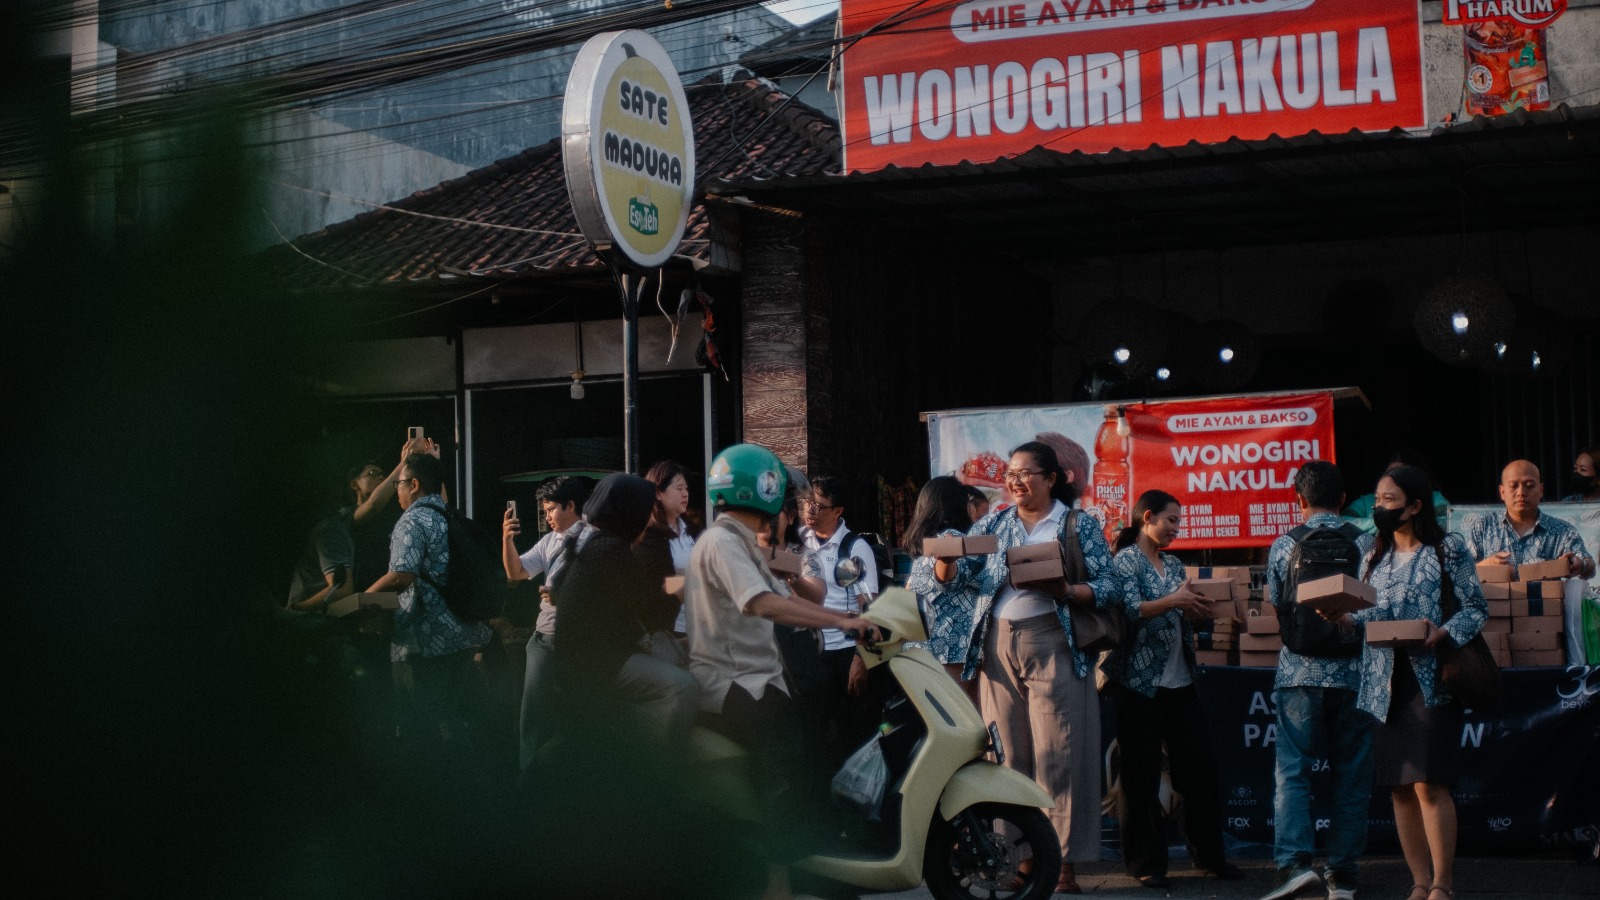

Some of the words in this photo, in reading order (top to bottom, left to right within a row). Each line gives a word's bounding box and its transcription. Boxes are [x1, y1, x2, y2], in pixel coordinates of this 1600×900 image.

[971, 3, 1026, 32] MIE
[1037, 0, 1135, 26] AYAM
[864, 48, 1142, 146] WONOGIRI
[1161, 26, 1397, 120] NAKULA
[620, 80, 668, 126] SATE
[604, 131, 682, 186] MADURA
[1175, 418, 1199, 429] MIE
[1203, 415, 1243, 428] AYAM
[1247, 414, 1256, 425] &
[1260, 411, 1308, 424] BAKSO
[1170, 439, 1320, 467] WONOGIRI
[1188, 467, 1299, 493] NAKULA
[1180, 505, 1188, 515] IE
[1190, 504, 1213, 515] AYAM
[1249, 503, 1265, 514] MIE
[1266, 502, 1290, 513] AYAM
[1190, 515, 1213, 526] AYAM
[1215, 514, 1240, 525] BAKSO
[1250, 515, 1265, 525] MIE
[1267, 513, 1290, 525] AYAM
[1191, 527, 1214, 538] AYAM
[1216, 526, 1240, 537] CEKER
[1251, 525, 1276, 536] BAKSO
[1228, 817, 1250, 828] FOX
